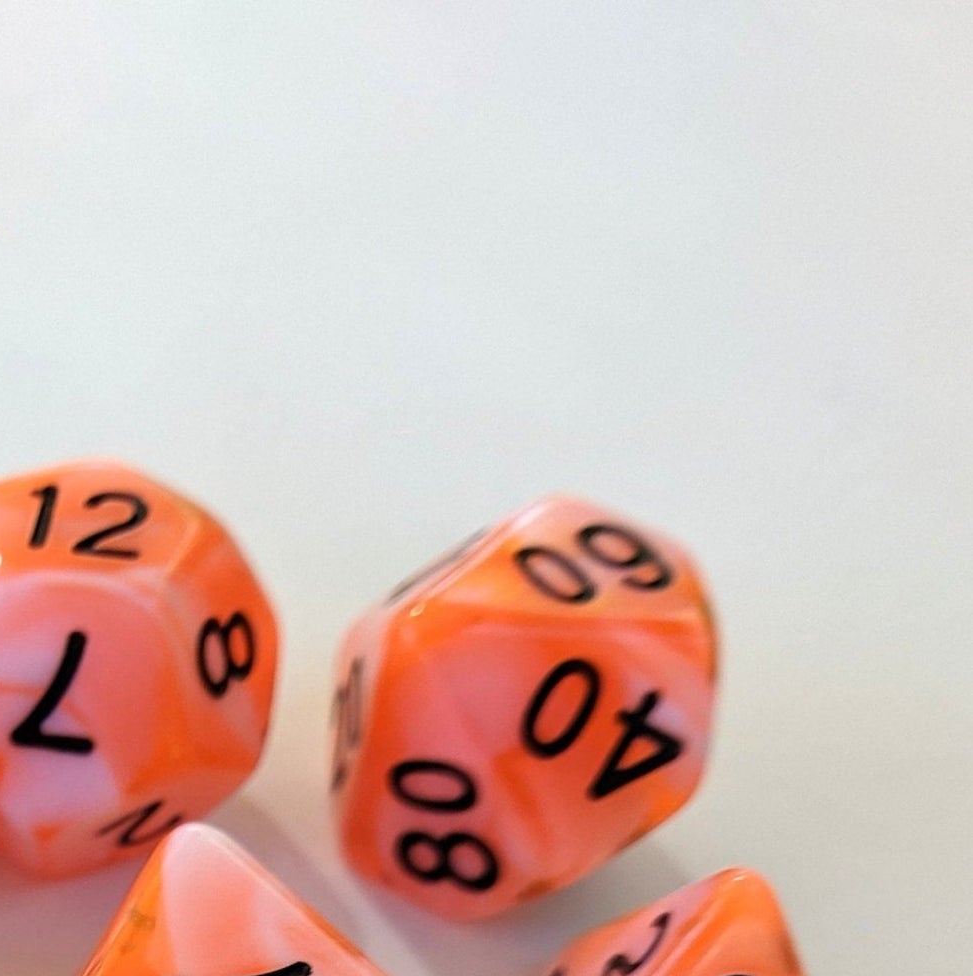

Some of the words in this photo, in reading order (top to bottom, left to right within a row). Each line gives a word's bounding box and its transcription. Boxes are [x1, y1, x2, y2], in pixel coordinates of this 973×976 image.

[29, 485, 148, 559] 12
[10, 631, 95, 757] 7
[196, 611, 255, 699] 8
[521, 658, 683, 800] 40
[389, 759, 501, 893] 80
